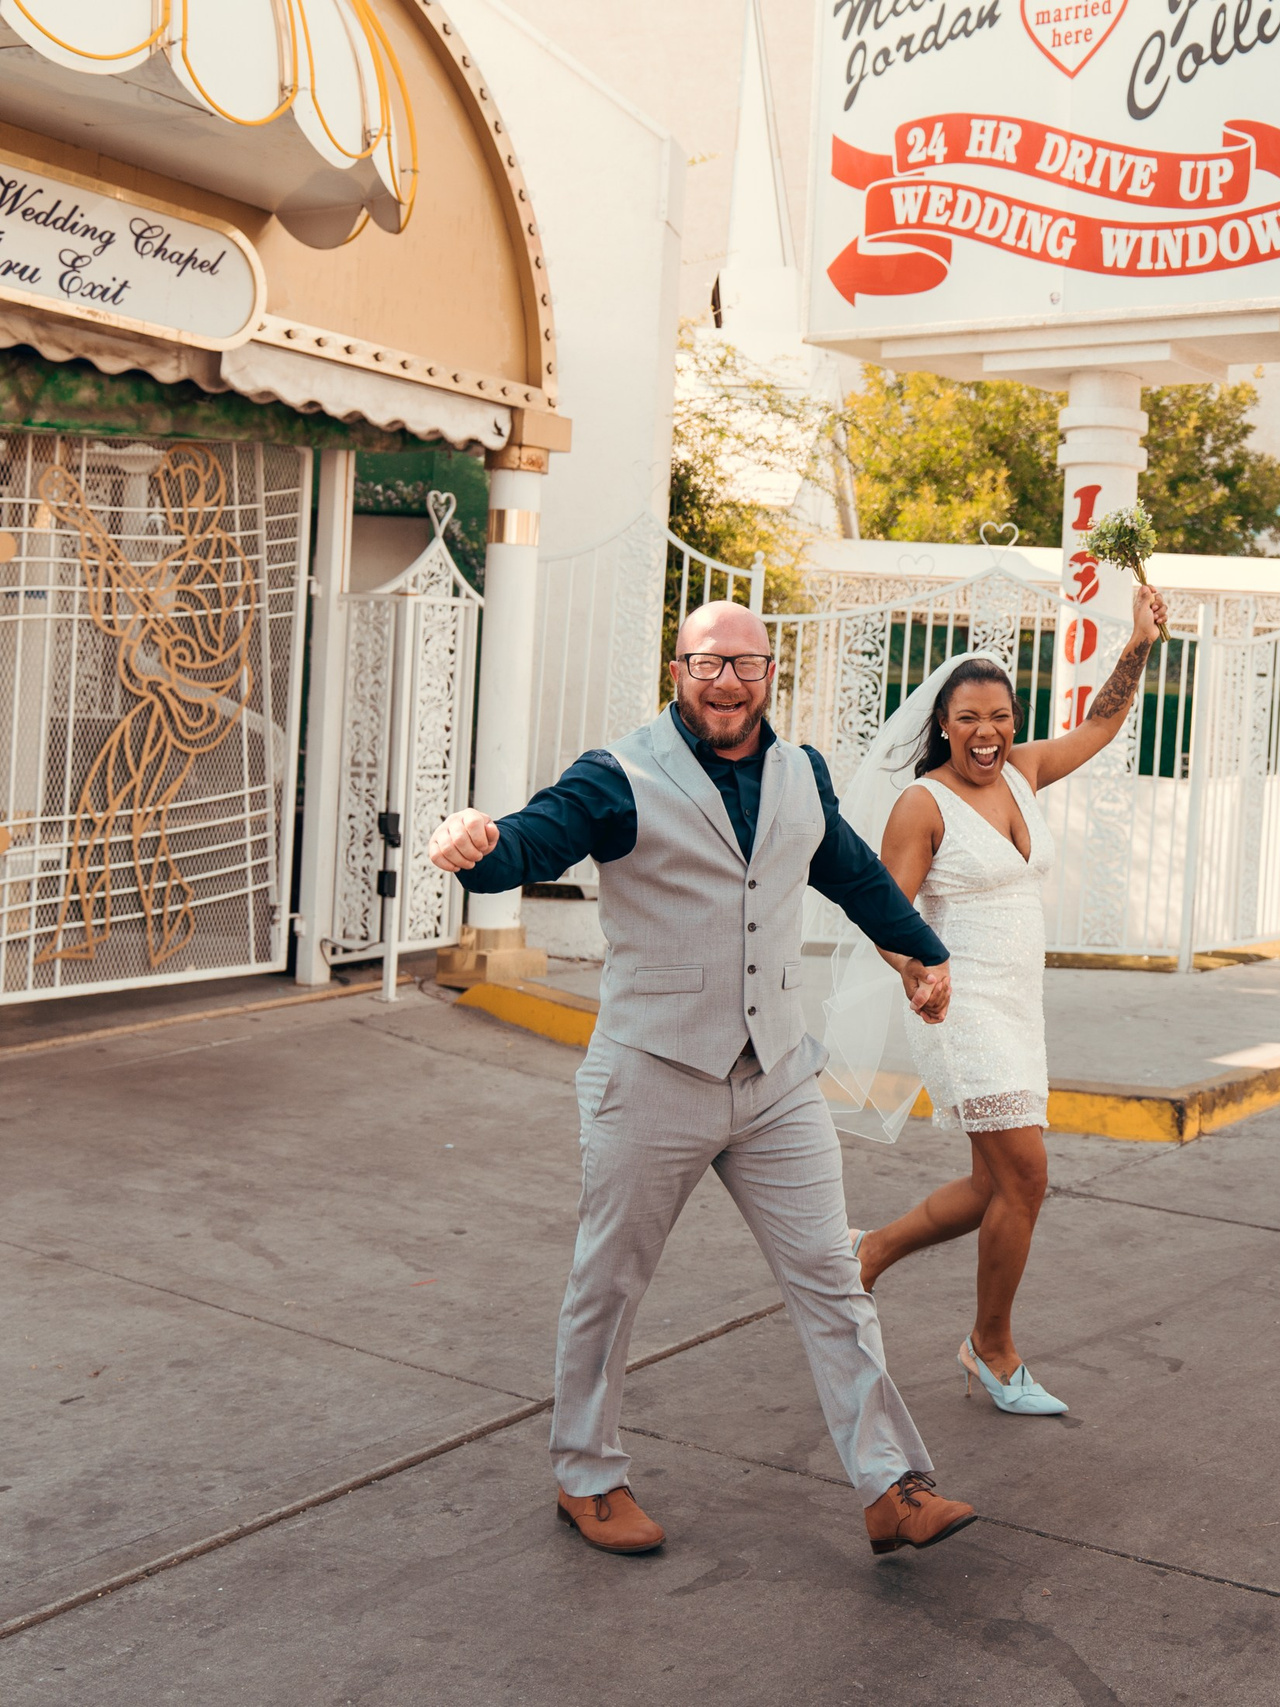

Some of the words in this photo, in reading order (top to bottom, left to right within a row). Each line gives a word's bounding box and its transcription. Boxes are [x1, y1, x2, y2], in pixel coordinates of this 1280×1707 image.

[1035, 0, 1112, 25] married
[1051, 27, 1092, 48] here
[843, 0, 1001, 111] Jordan
[906, 122, 947, 164] 24
[965, 119, 1022, 164] HR
[1035, 133, 1158, 197] DRIVE
[1179, 158, 1234, 201] UP
[0, 175, 116, 257] Wedding
[129, 217, 227, 277] Chapel
[890, 186, 1079, 261] WEDDING
[59, 248, 131, 305] Exit
